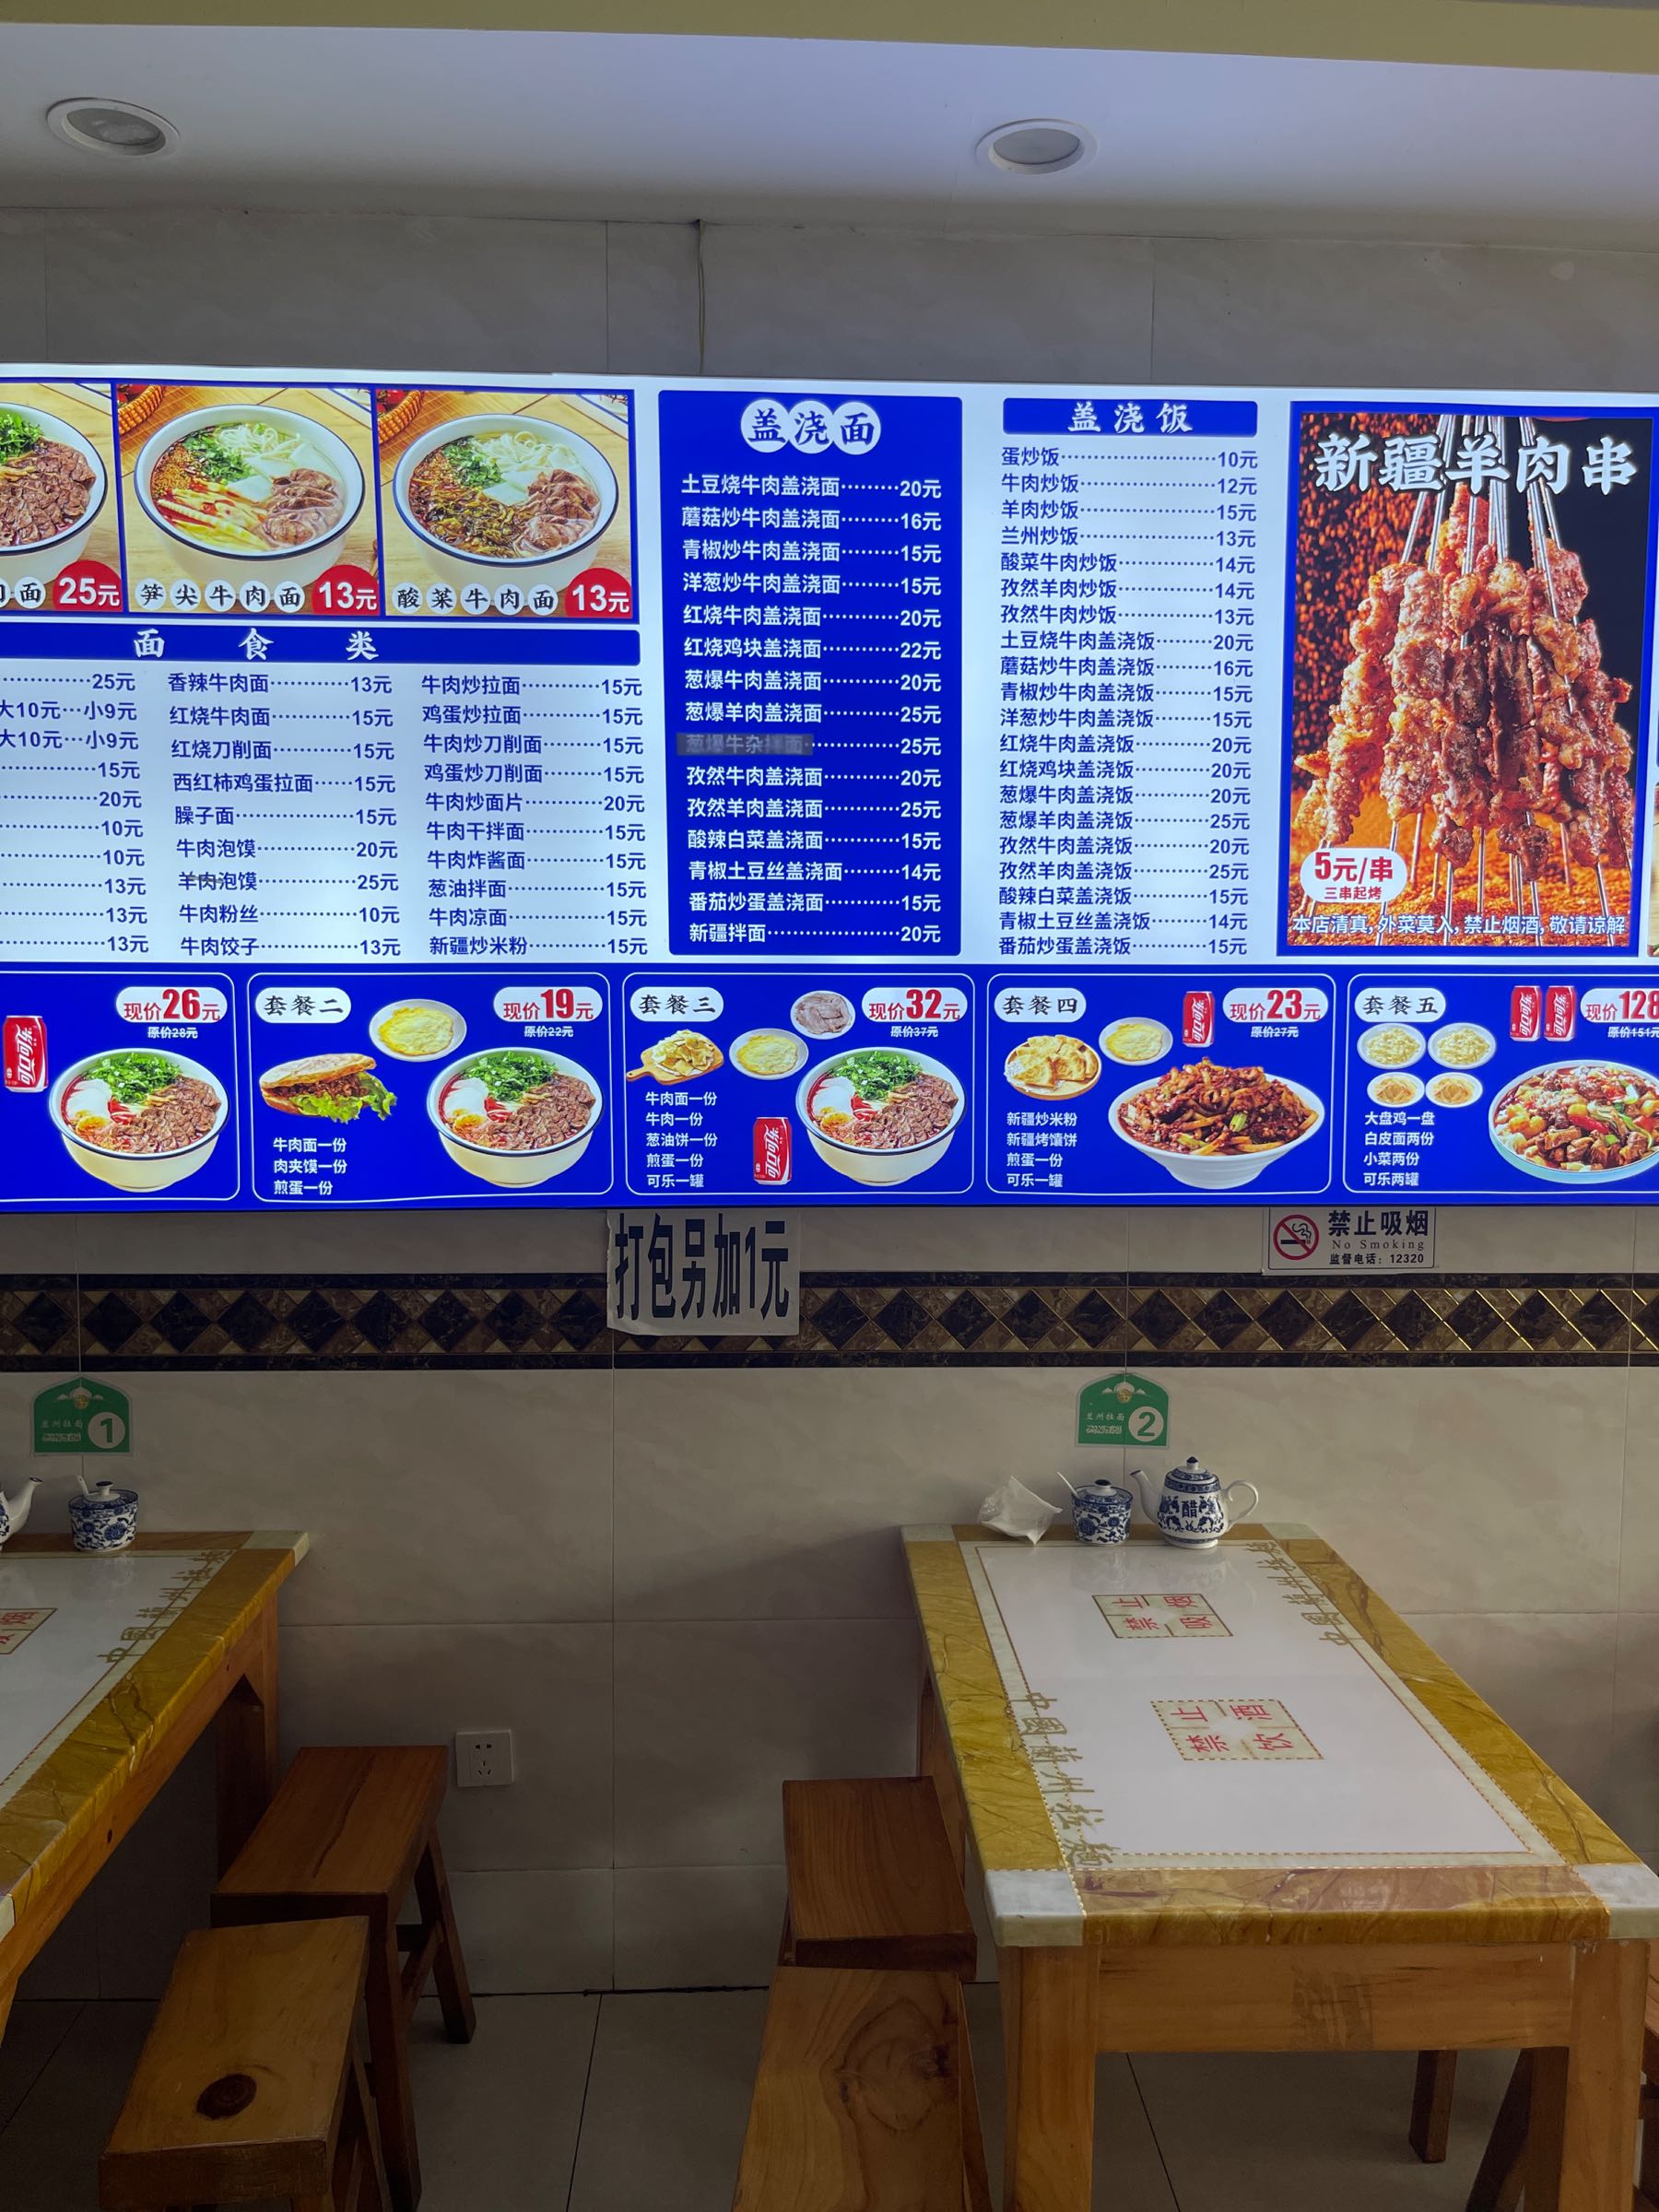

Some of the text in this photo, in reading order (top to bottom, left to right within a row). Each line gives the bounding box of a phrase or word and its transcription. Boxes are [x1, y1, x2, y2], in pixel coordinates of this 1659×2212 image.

[747, 407, 875, 446] 盖浇面
[1067, 401, 1193, 434] 盖浇饭
[1002, 447, 1257, 468] 蛋炒饭 10元
[1313, 432, 1637, 496] 新疆羊肉串
[682, 474, 941, 498] 土豆烧牛肉盖浇面 20元
[1002, 473, 1078, 493] 牛肉炒饭
[682, 507, 840, 529] 蘑菇炒牛肉盖浇面
[1002, 500, 1256, 521] 羊肉炒饭 15元
[1002, 526, 1077, 546] 兰州炒饭
[683, 539, 941, 563] 青椒炒牛肉盖浇面 15元
[1001, 552, 1254, 573] 酸菜牛肉炒饭 14元
[59, 577, 120, 606] 25元
[683, 572, 841, 594] 洋葱炒牛肉盖浇面
[1001, 578, 1116, 598] 孜然羊肉炒饭
[141, 581, 377, 609] 笋尖牛肉面 13元
[397, 584, 629, 612] 酸菜牛肉面 13元
[684, 605, 941, 628] 红烧牛肉盖浇面 20元
[1001, 605, 1253, 626] 孜然牛肉炒饭 13元
[684, 637, 821, 658] 红烧鸡块盖浇面
[1001, 630, 1154, 650] 土豆烧牛肉盖浇饭
[1001, 656, 1253, 677] 蘑菇炒牛肉盖浇饭 16元
[93, 673, 135, 690] 25元
[168, 673, 392, 693] 香辣牛肉面 13元
[422, 676, 642, 696] 牛肉炒拉面 15元
[685, 669, 941, 691] 葱爆牛肉盖浇面 20元
[1001, 682, 1154, 701] 青椒炒牛肉盖浇饭
[84, 701, 136, 720] 小9元
[170, 706, 270, 726] 红烧牛肉面
[423, 705, 521, 724] 鸡蛋炒拉面
[686, 701, 821, 723] 葱爆羊肉盖浇面
[1001, 708, 1252, 728] 洋葱炒牛肉盖浇饭 15元
[86, 730, 138, 749] 小9元
[171, 739, 394, 759] 红烧刀削面 15元
[424, 734, 643, 754] 牛肉炒刀削面 15元
[901, 737, 941, 755] 25元
[1000, 734, 1134, 753] 红烧牛肉盖浇饭
[99, 761, 140, 779] 15元
[425, 763, 542, 782] 鸡蛋炒刀削面
[687, 766, 822, 786] 孜然牛肉盖浇面
[1000, 759, 1251, 779] 红烧鸡块盖浇饭 20元
[173, 773, 312, 793] 西红柿鸡蛋拉面
[100, 791, 142, 807] 20元
[426, 793, 644, 812] 牛肉炒面片 20元
[1000, 785, 1133, 804] 葱爆牛肉盖浇饭
[175, 806, 396, 826] 臊子面 15元
[688, 798, 941, 818] 孜然羊肉盖浇面 25元
[101, 820, 143, 837] 10元
[1000, 810, 1250, 830] 葱爆羊肉盖浇饭 25元
[427, 821, 524, 841] 牛肉干拌面
[688, 830, 823, 849] 酸辣白菜盖浇面
[177, 839, 255, 858] 牛肉泡馍
[1000, 836, 1132, 854] 孜然牛肉盖浇饭
[103, 849, 145, 866] 10元
[428, 851, 645, 870] 牛肉炸酱面 15元
[1314, 853, 1394, 882] 5元/串
[688, 861, 941, 881] 青椒土豆丝盖浇面 14元
[999, 862, 1249, 880] 孜然羊肉盖浇饭 25元
[105, 877, 146, 895] 13元
[358, 874, 398, 890] 25元
[429, 879, 506, 898] 葱油拌面
[689, 892, 823, 912] 番茄炒蛋盖浇面
[999, 887, 1131, 905] 酸辣白菜盖浇饭
[1324, 887, 1382, 900] 三串起烤
[107, 907, 147, 924] 13元
[180, 904, 258, 923] 牛肉粉丝
[429, 908, 647, 926] 牛肉凉面 15元
[999, 912, 1247, 930] 青椒土豆丝盖浇饭 14元
[689, 924, 940, 942] 新疆拌面 20元
[108, 935, 148, 952] 13元
[181, 936, 401, 956] 牛肉饺子 13元
[429, 936, 527, 955] 新疆炒米粉
[999, 936, 1130, 955] 番茄炒蛋盖浇饭
[124, 988, 220, 1021] 现价26元
[264, 995, 344, 1016] 套餐二
[503, 988, 594, 1020] 现价19元
[639, 994, 716, 1016] 套餐三
[868, 989, 961, 1021] 现价32元
[1003, 995, 1077, 1016] 套餐四
[1230, 989, 1322, 1021] 现价23元
[1363, 995, 1438, 1015] 套餐五
[646, 1091, 717, 1105] 牛肉面一份
[646, 1112, 703, 1126] 牛肉一份
[1007, 1112, 1077, 1126] 新疆炒米粉
[1365, 1112, 1435, 1125] 大盘鸡一盘
[274, 1137, 347, 1152] 牛肉面一份
[646, 1133, 717, 1147] 葱油饼一份
[1007, 1133, 1077, 1147] 新疆烤馕饼
[1365, 1132, 1434, 1146] 白皮面两份
[274, 1159, 347, 1173] 肉夹馍一份
[647, 1153, 703, 1167] 煎蛋一份
[1006, 1152, 1063, 1167] 煎蛋一份
[1364, 1152, 1419, 1166] 小菜两份
[274, 1180, 333, 1194] 煎蛋一份
[647, 1174, 703, 1188] 可乐一罐
[1006, 1173, 1063, 1187] 可乐一罐
[1363, 1172, 1418, 1186] 可乐两罐
[1328, 1210, 1428, 1236] 禁止吸烟
[1332, 1240, 1424, 1251] No Smoking
[615, 1213, 789, 1321] 打包另加1元
[100, 1418, 113, 1443] 1
[1137, 1411, 1157, 1437] 2
[1182, 1500, 1198, 1518] 醋
